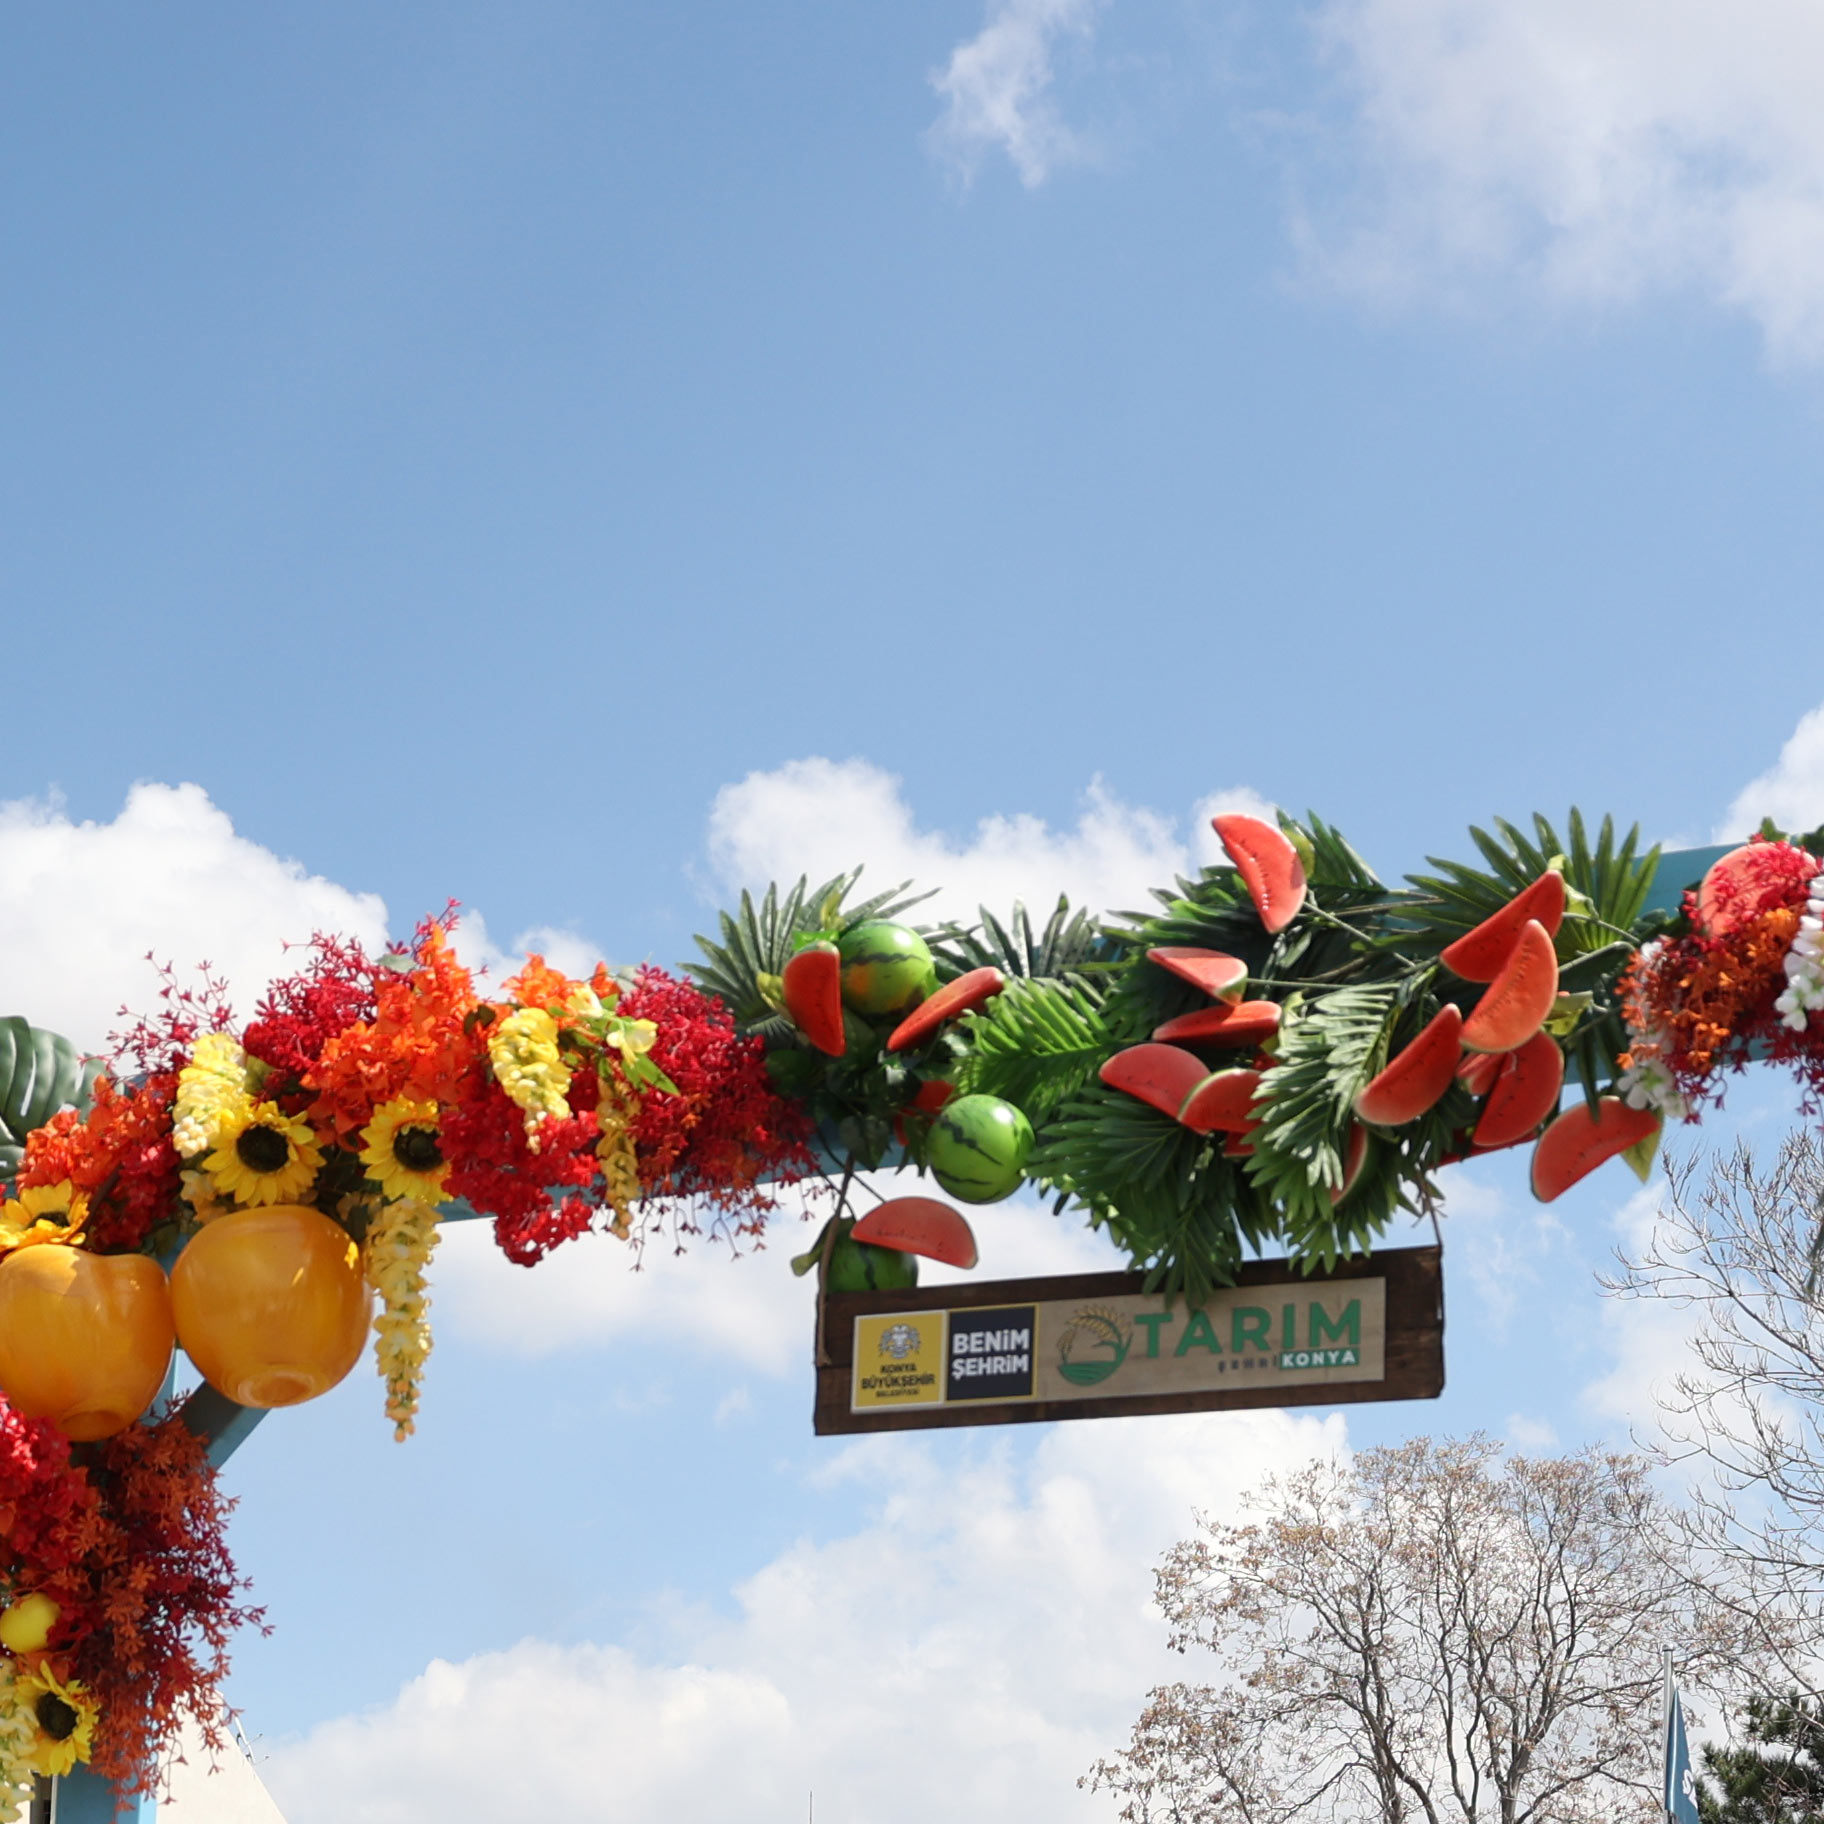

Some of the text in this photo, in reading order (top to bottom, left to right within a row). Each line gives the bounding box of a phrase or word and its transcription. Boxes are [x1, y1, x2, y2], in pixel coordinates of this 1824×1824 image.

[953, 1328, 1029, 1354] BENİM
[1134, 1299, 1361, 1358] TARIM
[952, 1354, 1029, 1381] ŞEHRİM
[1282, 1350, 1356, 1368] KONYA
[861, 1374, 935, 1389] BÜYÜKŞEHİR
